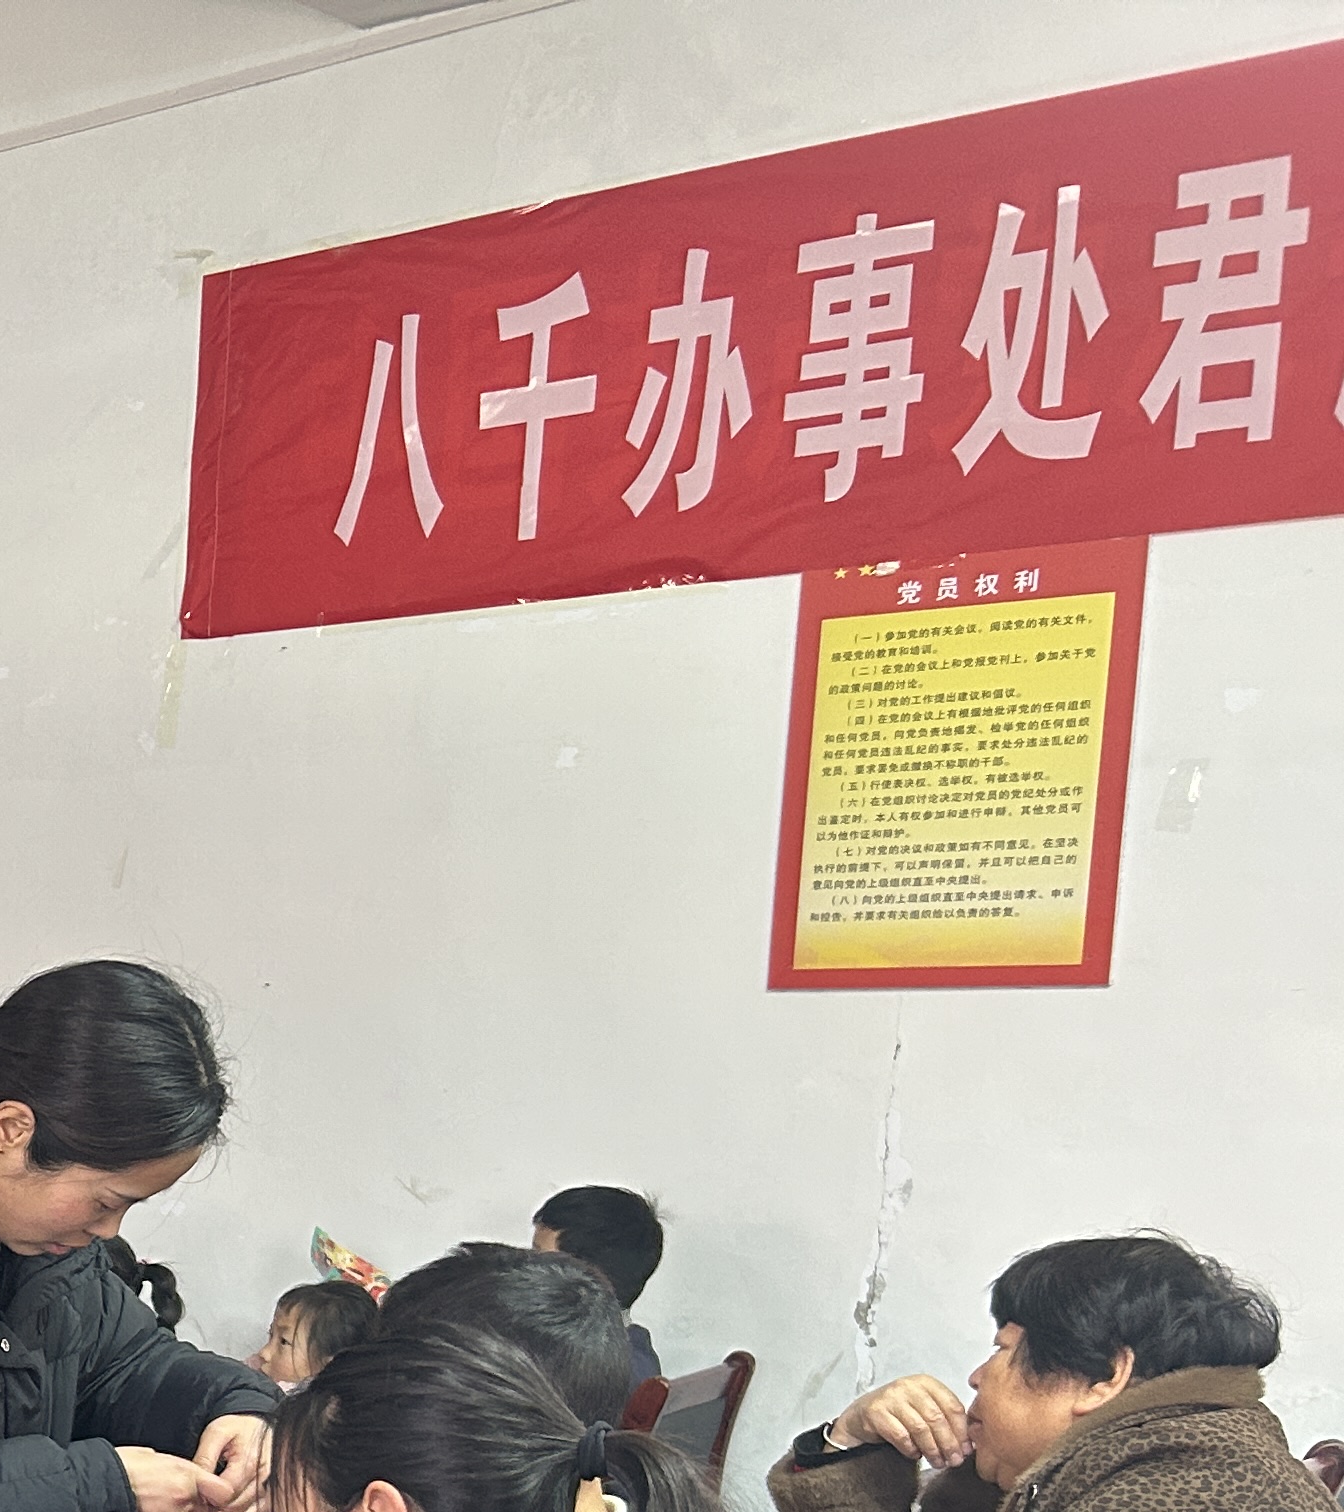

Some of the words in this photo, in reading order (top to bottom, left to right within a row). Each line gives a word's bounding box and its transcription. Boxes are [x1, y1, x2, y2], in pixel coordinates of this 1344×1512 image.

[333, 153, 1344, 548] 八千办事处君
[897, 568, 1040, 606] 党员权利
